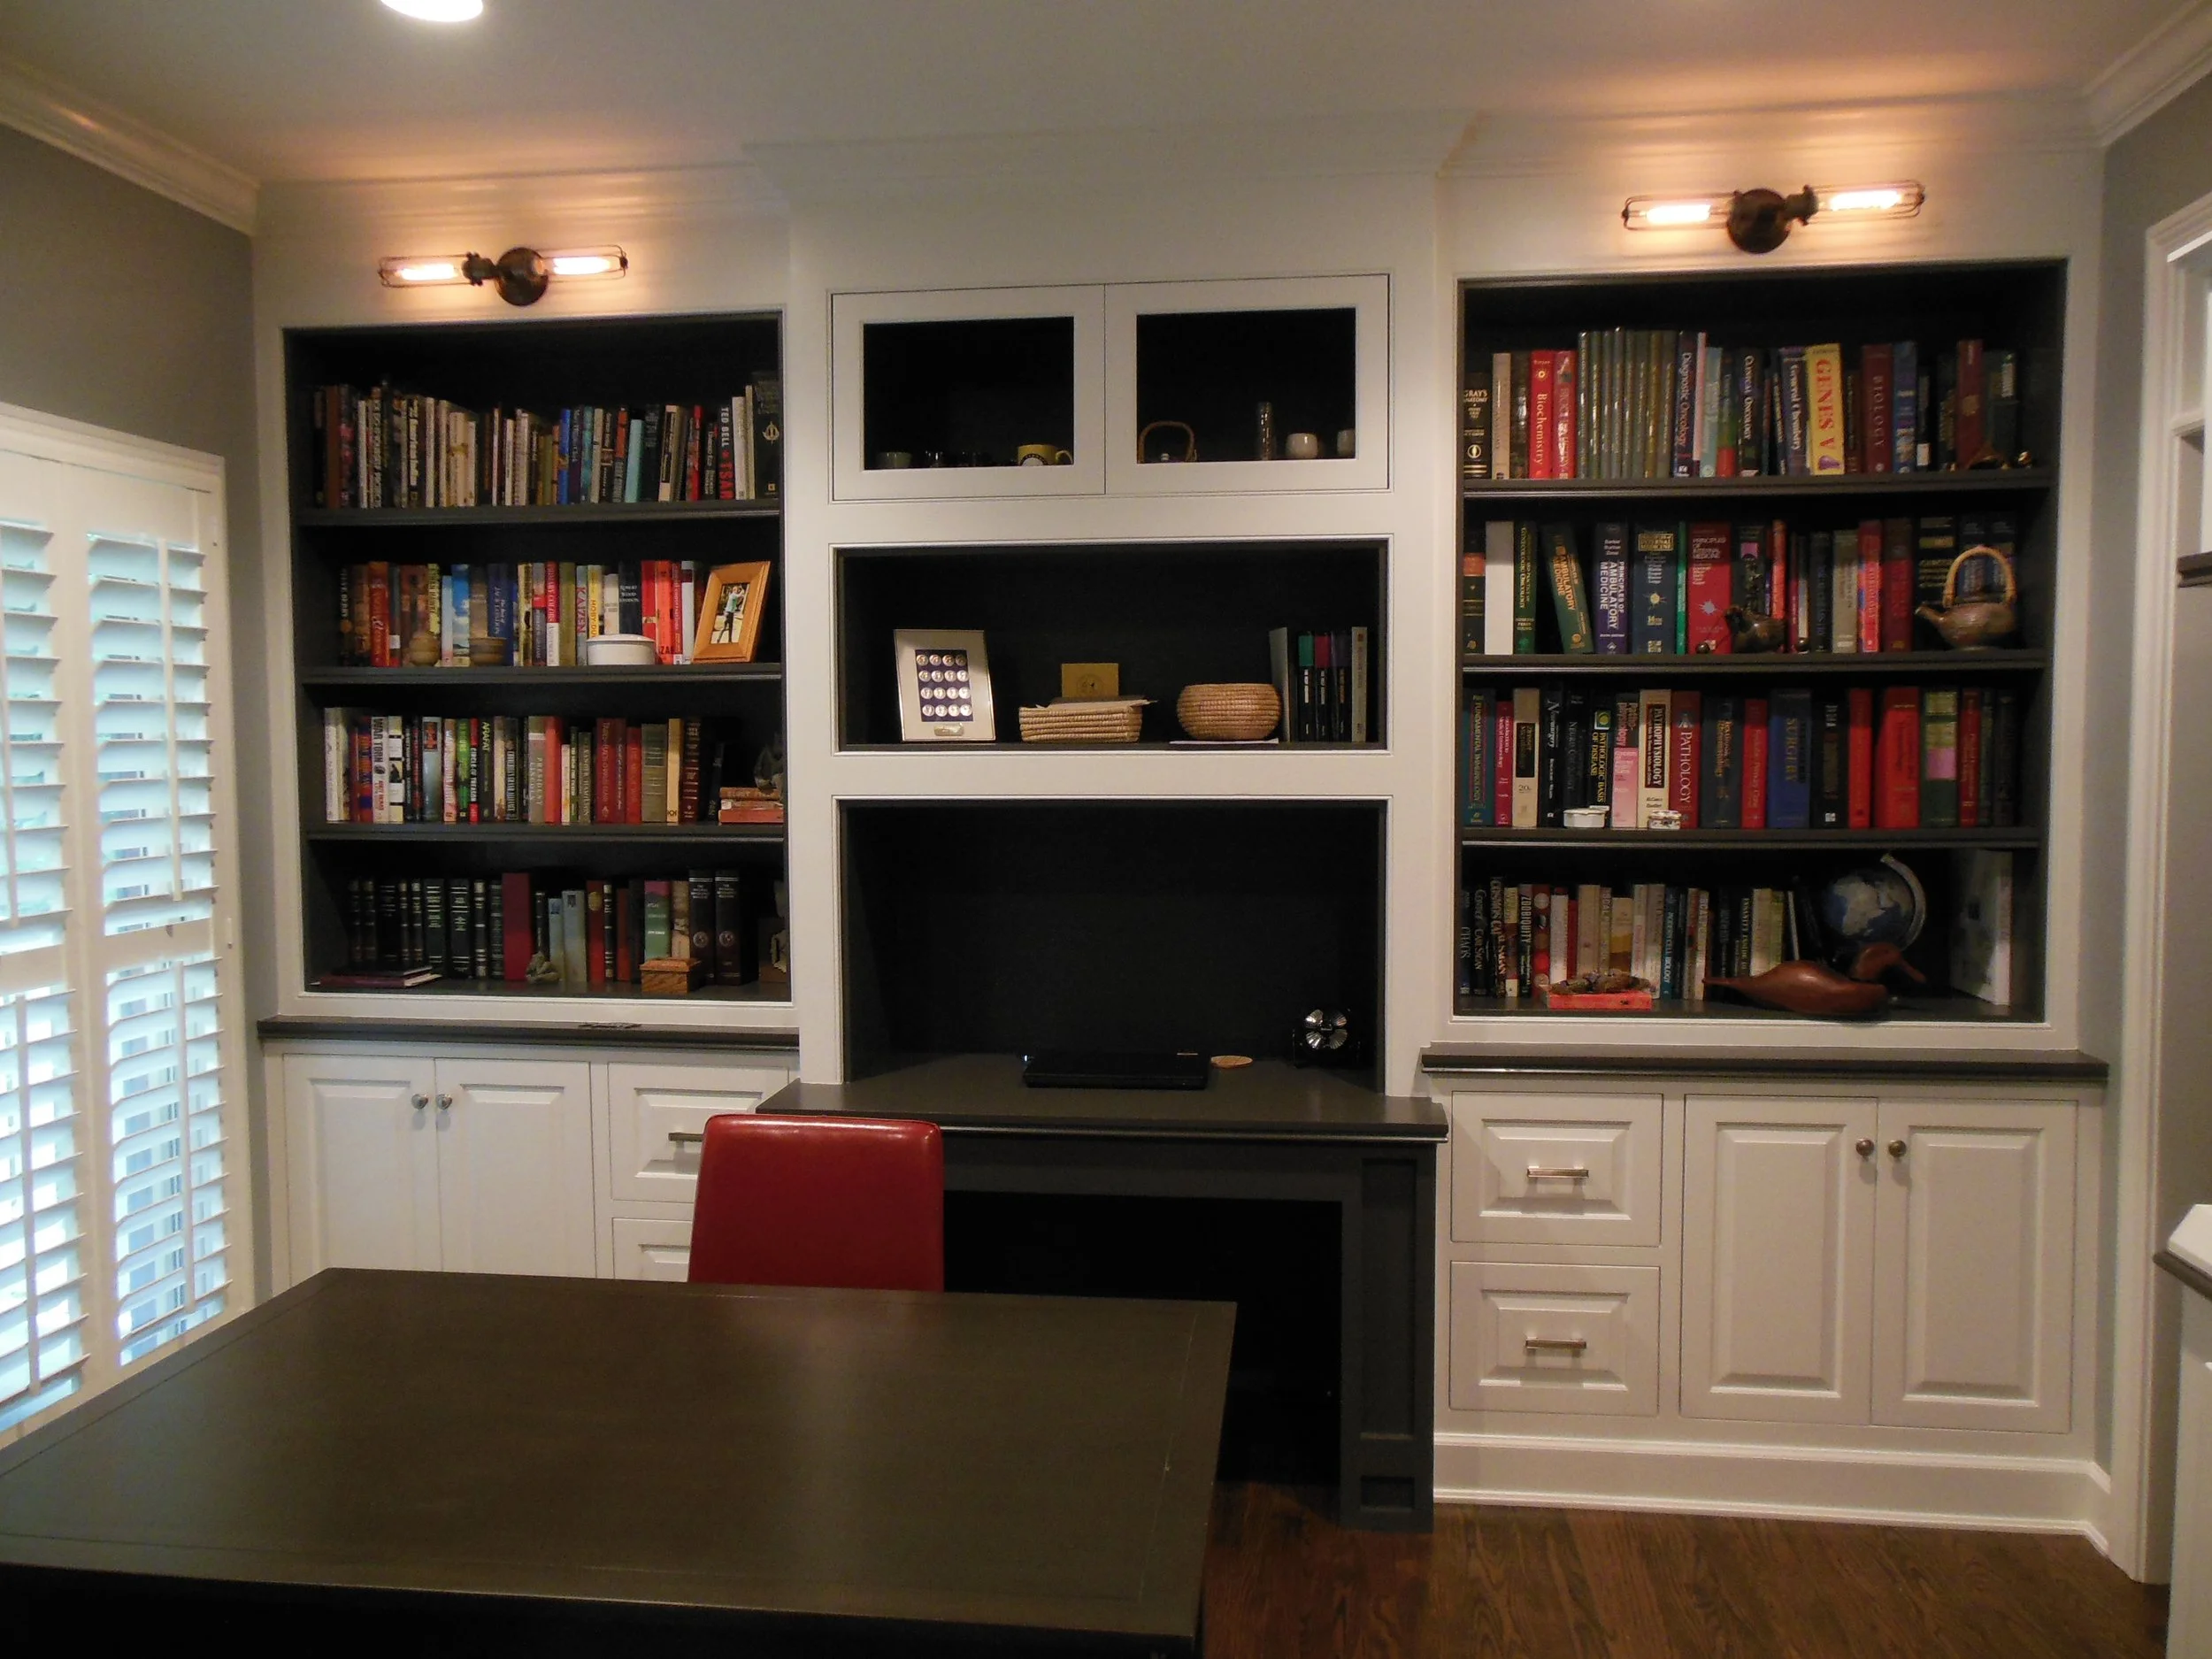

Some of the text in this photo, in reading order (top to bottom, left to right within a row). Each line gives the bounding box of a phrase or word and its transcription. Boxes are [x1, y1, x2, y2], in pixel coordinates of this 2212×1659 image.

[1678, 351, 1692, 447] Diagnostic Oncology
[1790, 364, 1801, 402] General
[1816, 358, 1835, 449] GENES V
[721, 407, 730, 448] TED BELL
[1534, 394, 1548, 465] Biochemistry
[1872, 374, 1886, 447] BIOLOGY
[718, 461, 734, 500] TSAR
[1553, 556, 1565, 596] MEDICINE
[1560, 555, 1576, 611] AMBULATORY
[1600, 561, 1609, 610] MEDICINE
[1609, 561, 1618, 629] AMBULATORY
[577, 587, 587, 634] KAIZEN
[1618, 603, 1624, 613] OF
[373, 718, 383, 763] WAR TORN
[1473, 702, 1482, 753] FUNDAMENTAL
[1592, 732, 1599, 742] OF
[1653, 708, 1663, 786] PATHOPHYSIOLOGY
[1786, 718, 1798, 781] SURGERY
[1597, 732, 1607, 803] PATHOLOGIC BASIS
[1680, 731, 1692, 803] PATHOLOGY
[1459, 926, 1471, 959] CHAOS
[1521, 896, 1532, 943] ZOOBIQUITY
